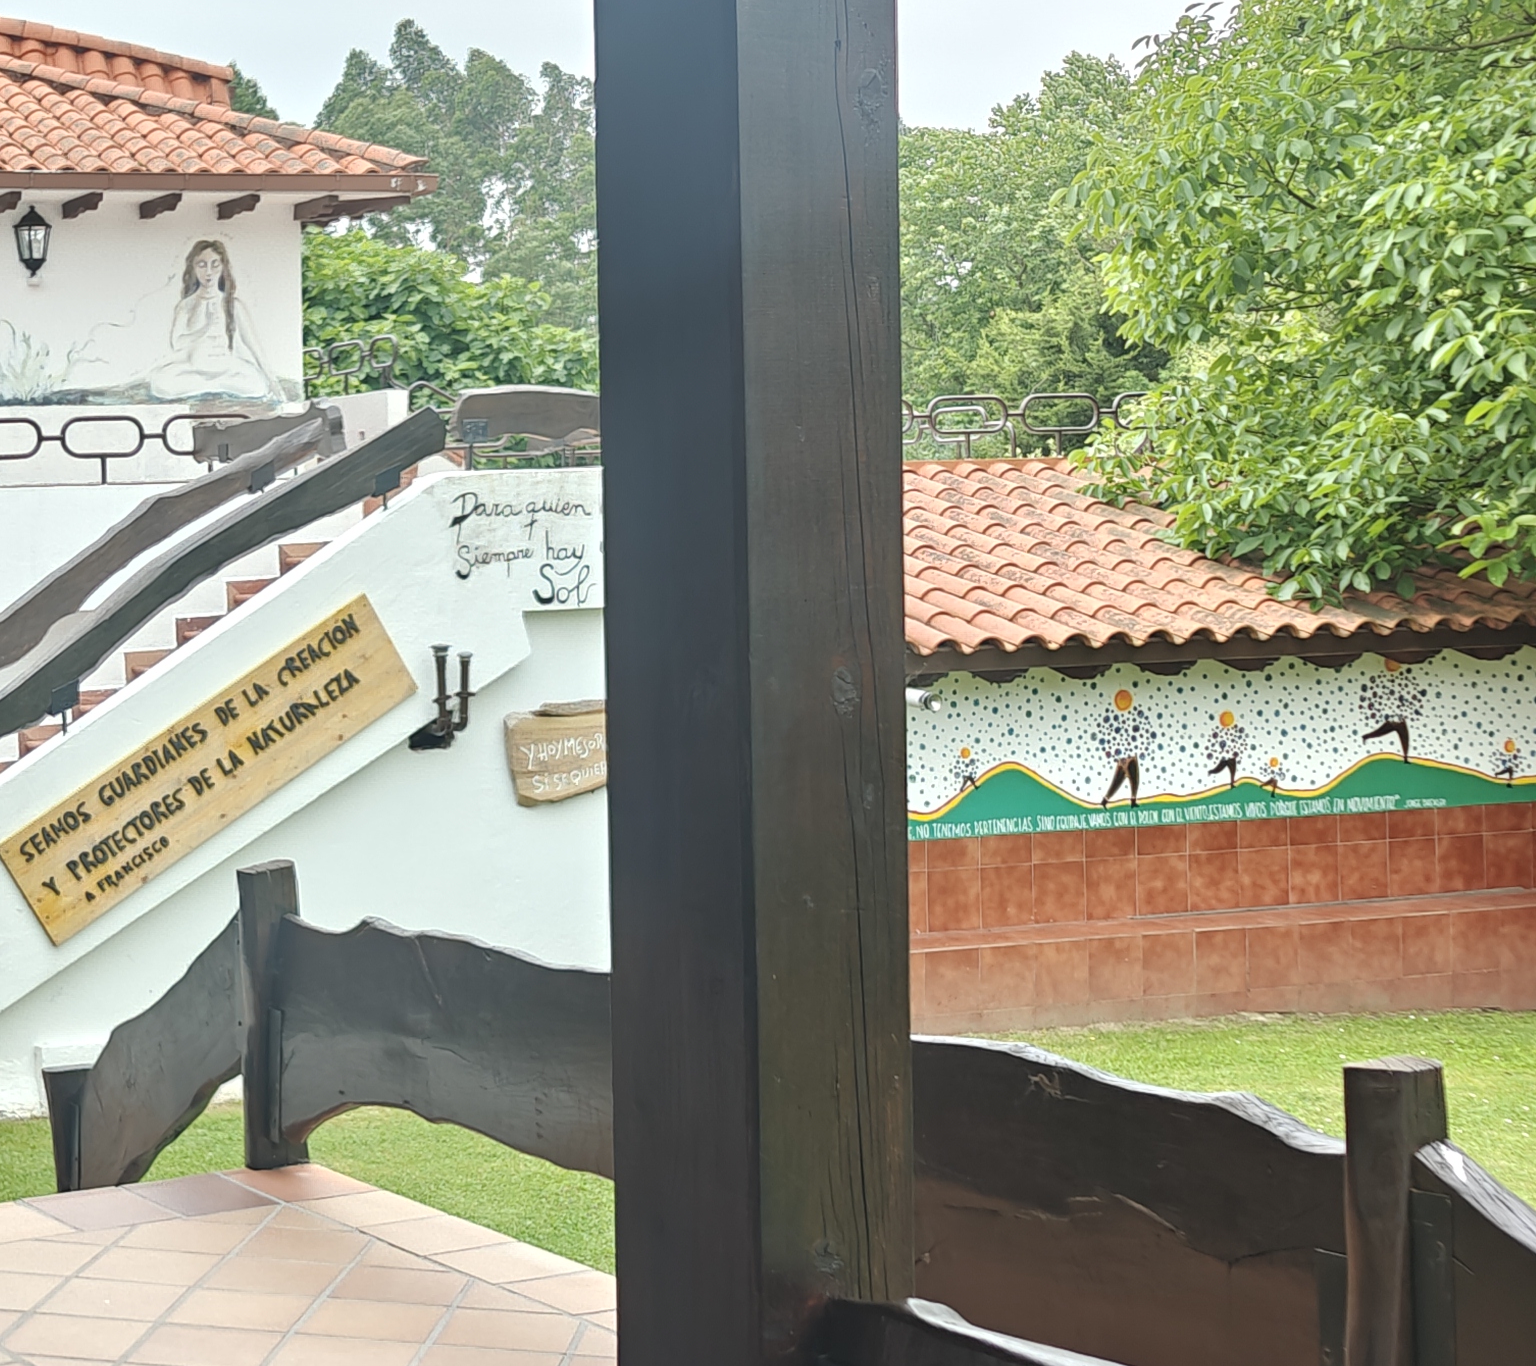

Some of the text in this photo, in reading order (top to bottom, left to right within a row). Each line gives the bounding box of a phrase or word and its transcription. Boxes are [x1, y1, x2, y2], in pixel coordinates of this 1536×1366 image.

[544, 530, 585, 576] hay
[532, 563, 597, 607] Sol
[20, 801, 92, 863] SEAMOS
[98, 722, 208, 806] GUARDIANES
[214, 698, 240, 727] DE
[242, 682, 270, 707] LA
[41, 668, 361, 896] Y PROTECTORES DE LA NATURALEZA
[916, 823, 930, 839] NO
[932, 822, 972, 838] TENEMOS
[1036, 814, 1055, 832] SINO
[97, 835, 170, 893] FRANCISCO
